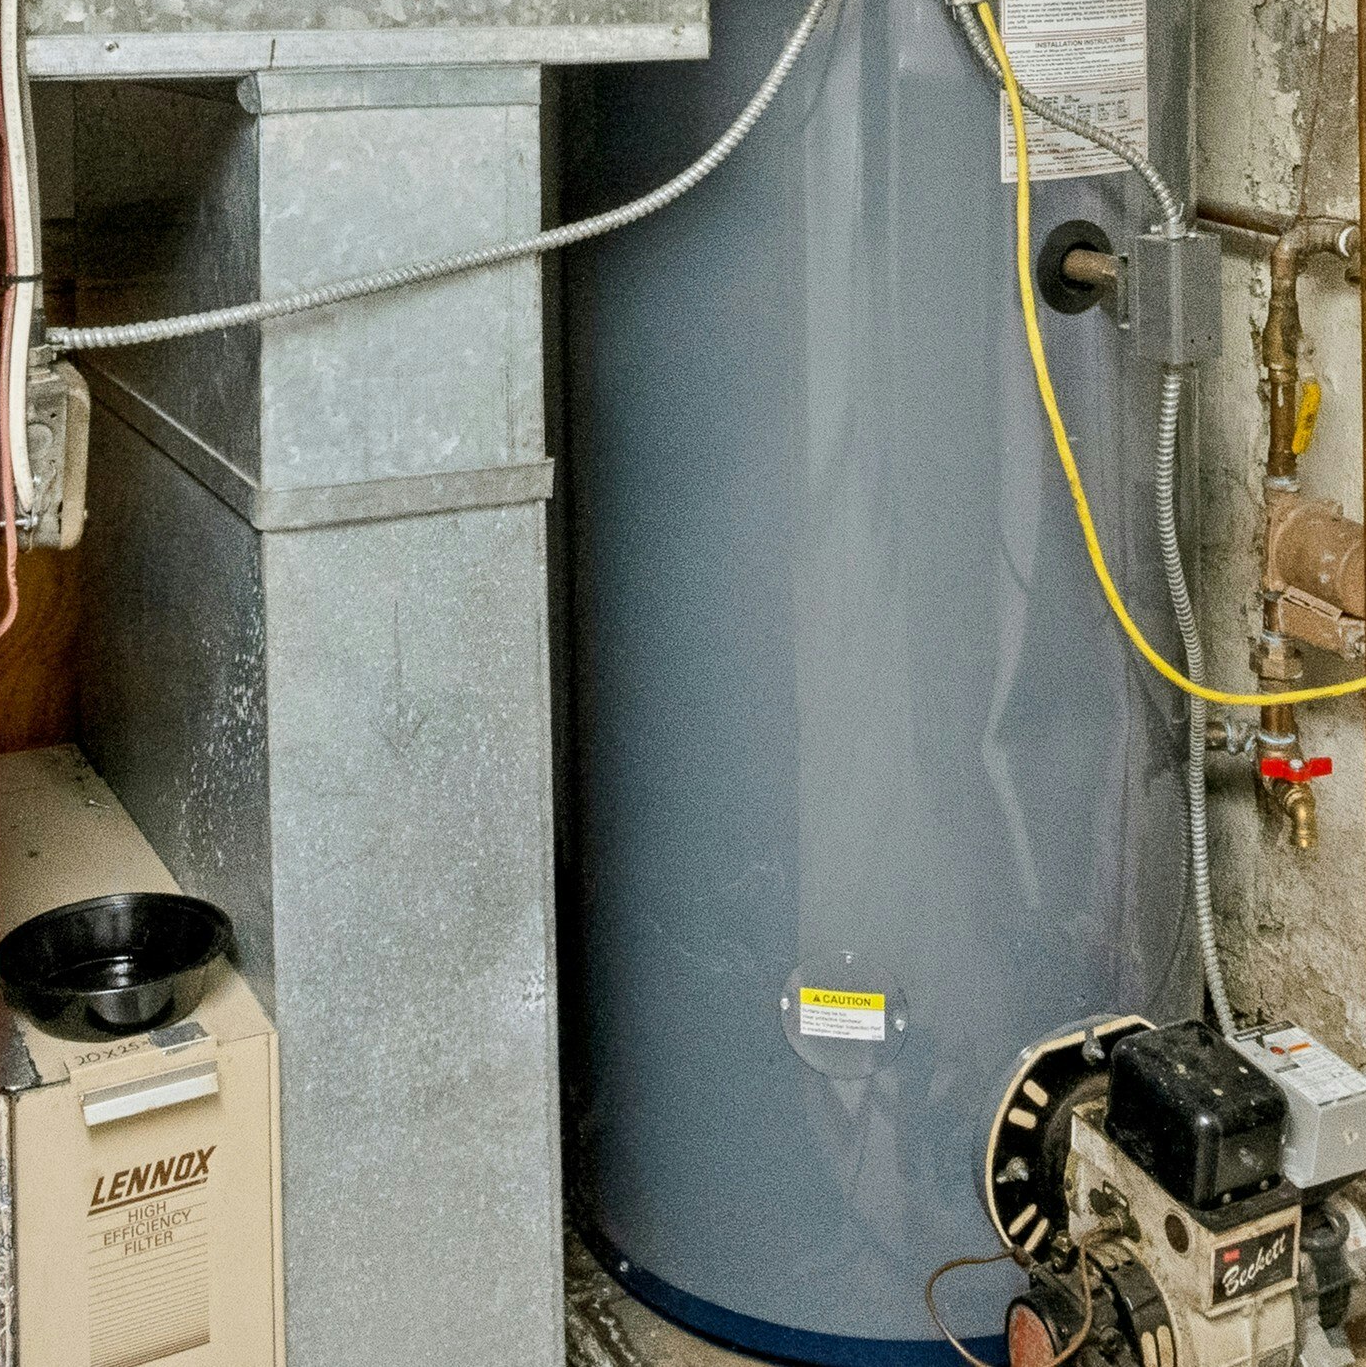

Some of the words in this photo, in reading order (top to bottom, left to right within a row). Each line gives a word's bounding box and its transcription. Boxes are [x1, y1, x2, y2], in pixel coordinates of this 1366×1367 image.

[1035, 39, 1083, 48] INSTALLATION
[1084, 37, 1126, 45] INSTRUCTIONS
[822, 994, 872, 1007] CAUTION
[90, 1145, 218, 1208] LENNOX
[127, 1200, 168, 1223] HIGH
[102, 1208, 193, 1247] EFFICIENCY
[123, 1230, 175, 1257] FILTER
[1222, 1232, 1286, 1297] Beckett
